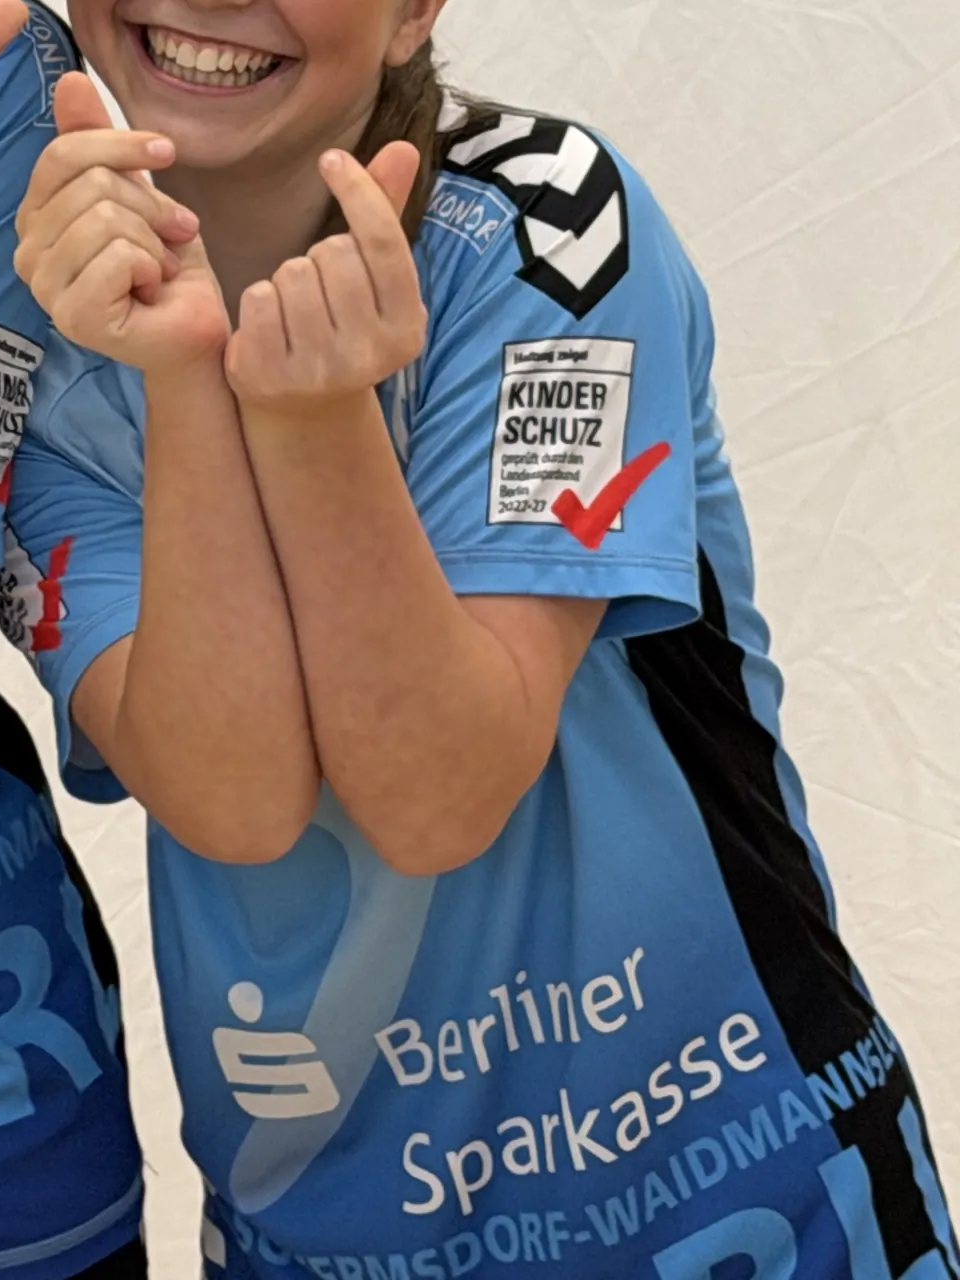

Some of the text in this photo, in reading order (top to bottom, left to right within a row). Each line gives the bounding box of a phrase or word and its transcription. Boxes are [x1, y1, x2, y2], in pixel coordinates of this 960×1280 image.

[502, 415, 603, 447] SCHUTZ
[507, 379, 608, 410] KINDER
[374, 947, 645, 1087] Berliner
[402, 1011, 767, 1216] Sparkasse
